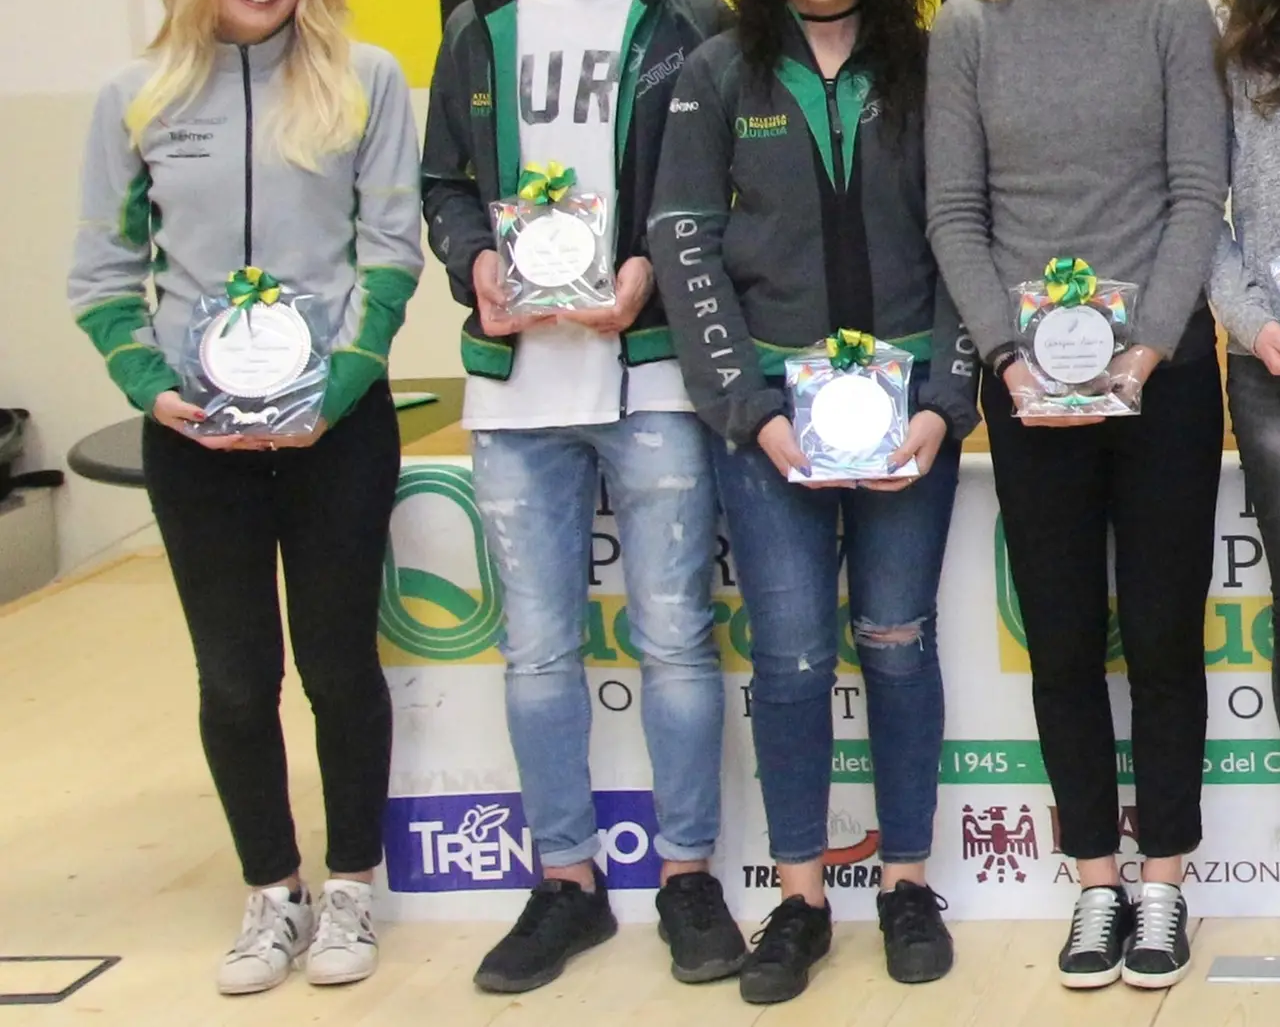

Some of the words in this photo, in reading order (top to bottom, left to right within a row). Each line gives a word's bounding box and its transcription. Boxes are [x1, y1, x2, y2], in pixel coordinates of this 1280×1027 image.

[674, 218, 741, 388] QUERCIA
[953, 752, 1009, 773] 1945
[1220, 752, 1255, 773] del
